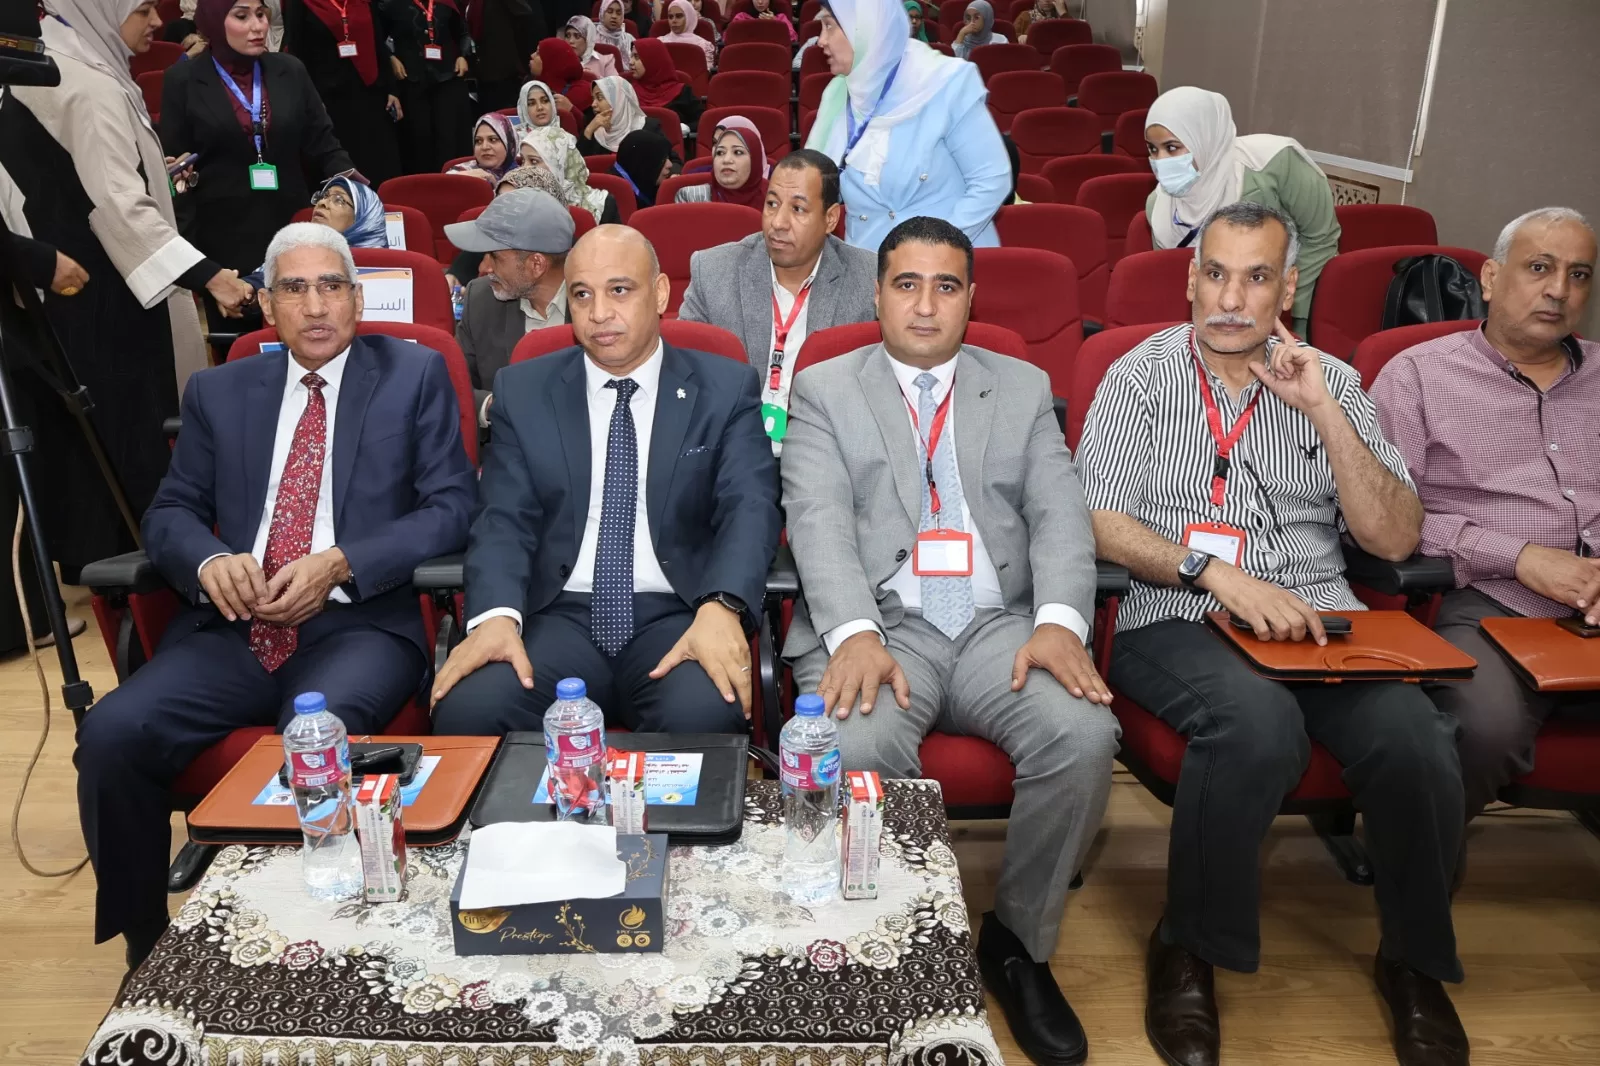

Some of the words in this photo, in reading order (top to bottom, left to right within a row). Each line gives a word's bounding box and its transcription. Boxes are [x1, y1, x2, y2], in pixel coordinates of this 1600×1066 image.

[363, 298, 406, 311] الس
[463, 911, 487, 924] fine
[498, 926, 554, 945] Prestige
